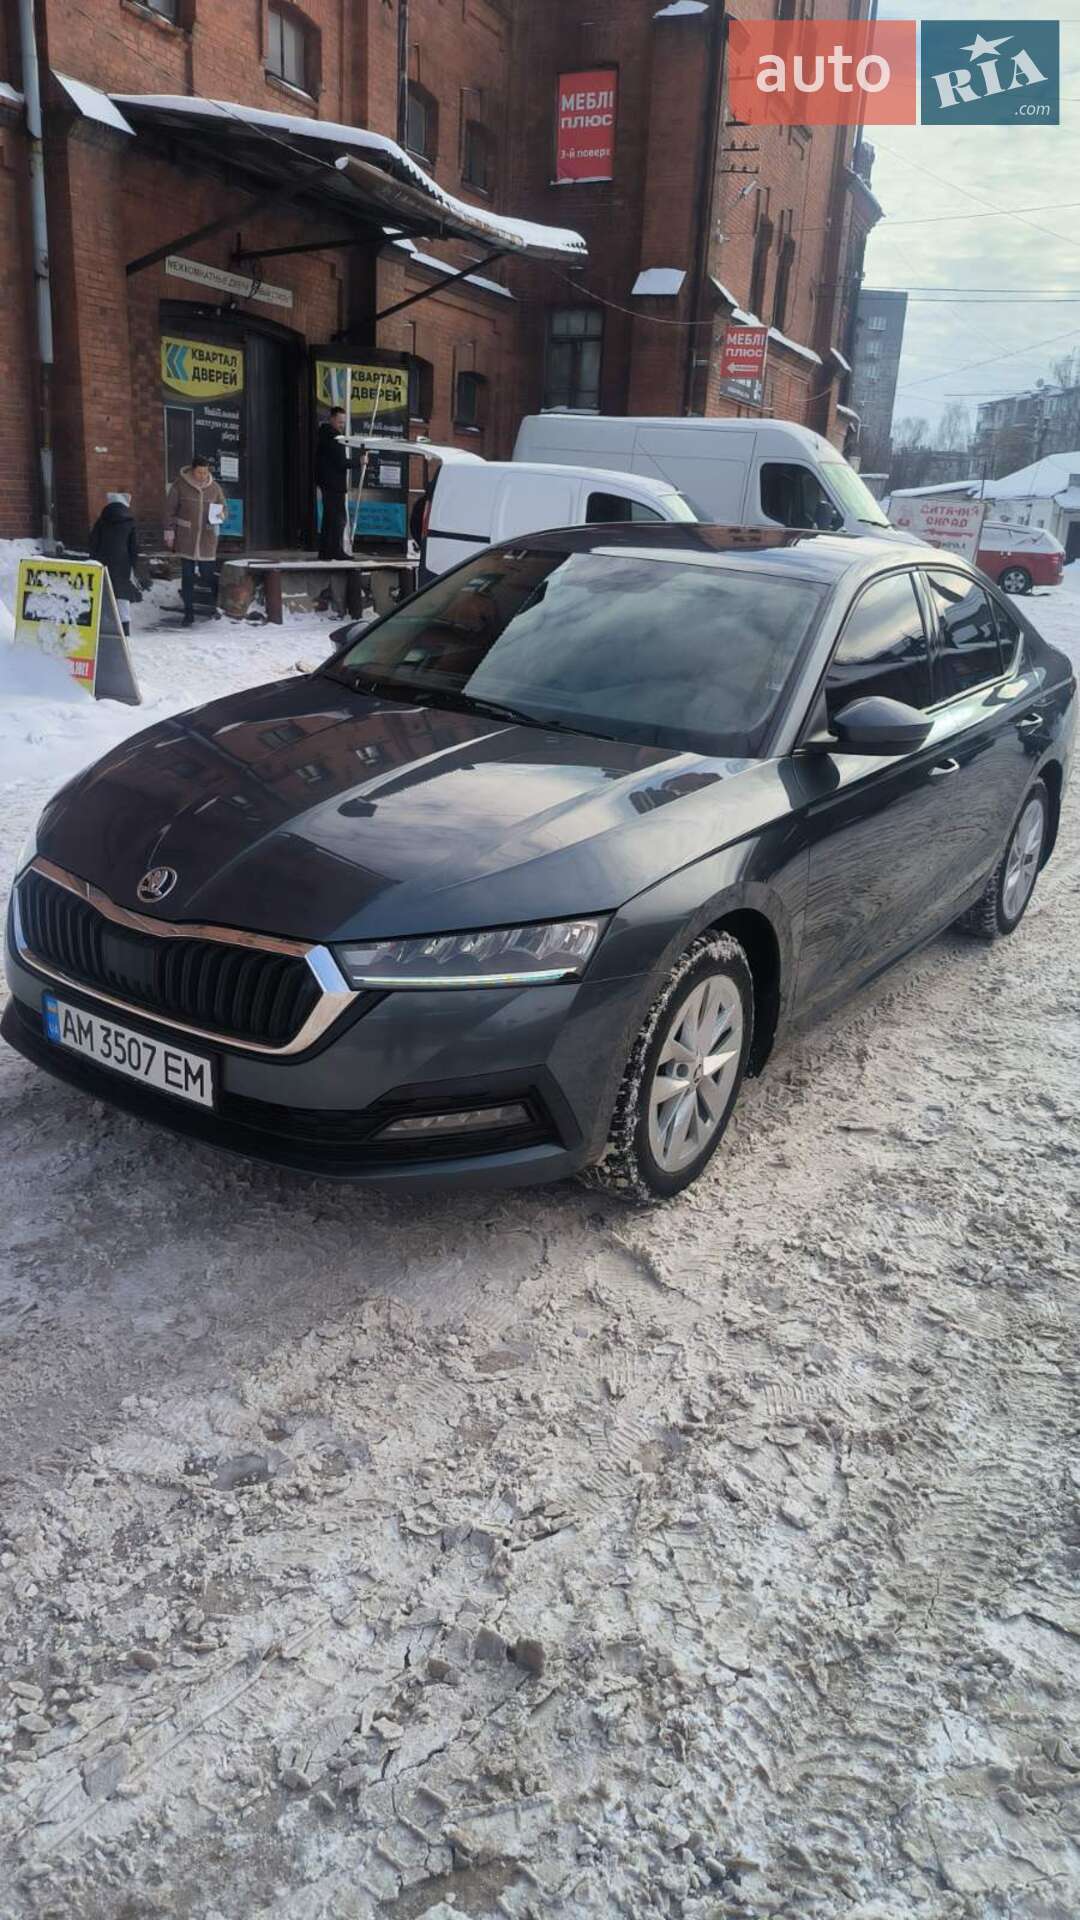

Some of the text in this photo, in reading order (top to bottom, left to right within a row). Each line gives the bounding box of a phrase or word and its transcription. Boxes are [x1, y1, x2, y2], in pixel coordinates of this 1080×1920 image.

[561, 90, 614, 112] МЕБЛІ
[561, 114, 614, 129] ПЛЮС
[726, 333, 764, 346] МЕБЛІ
[191, 348, 238, 368] КВАРТАЛ
[725, 347, 764, 358] ПЛЮС
[191, 366, 238, 386] ДВЕРЕЙ
[350, 369, 402, 386] КВАРТАЛ
[350, 386, 402, 402] ДВЕРЕЙ
[62, 1009, 205, 1098] AM 3507 EM
